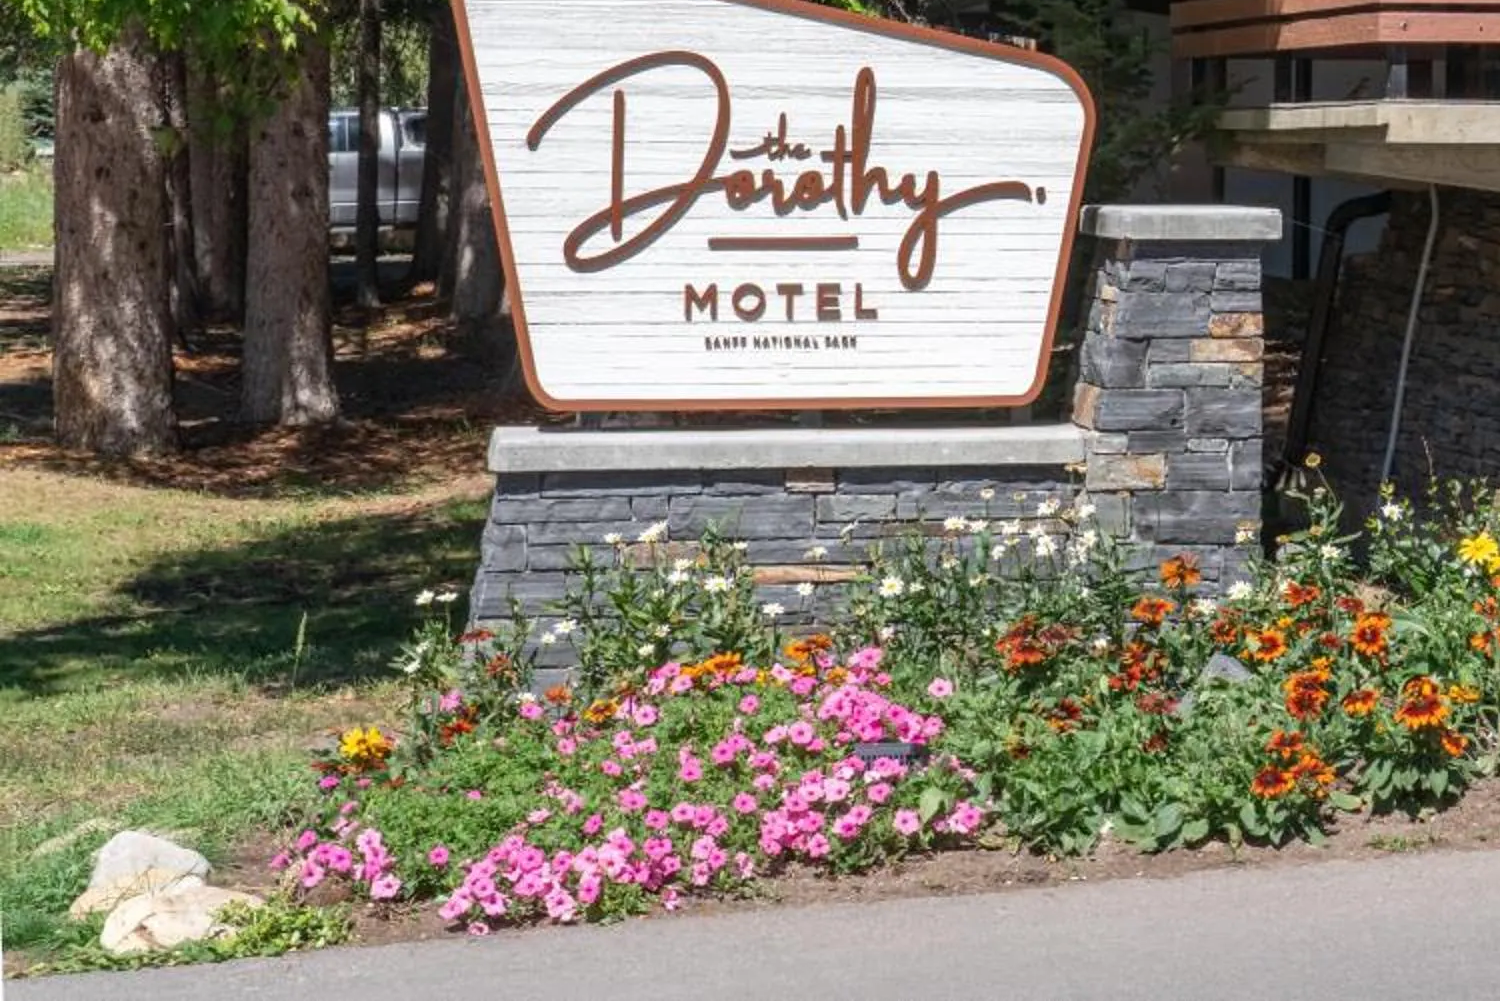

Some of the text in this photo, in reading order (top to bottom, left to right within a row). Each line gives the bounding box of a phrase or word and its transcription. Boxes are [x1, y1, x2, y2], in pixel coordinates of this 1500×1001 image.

[729, 111, 812, 161] the
[525, 49, 1034, 292] Dorothy
[684, 282, 879, 323] MOTEL
[753, 335, 820, 350] NATIONAL
